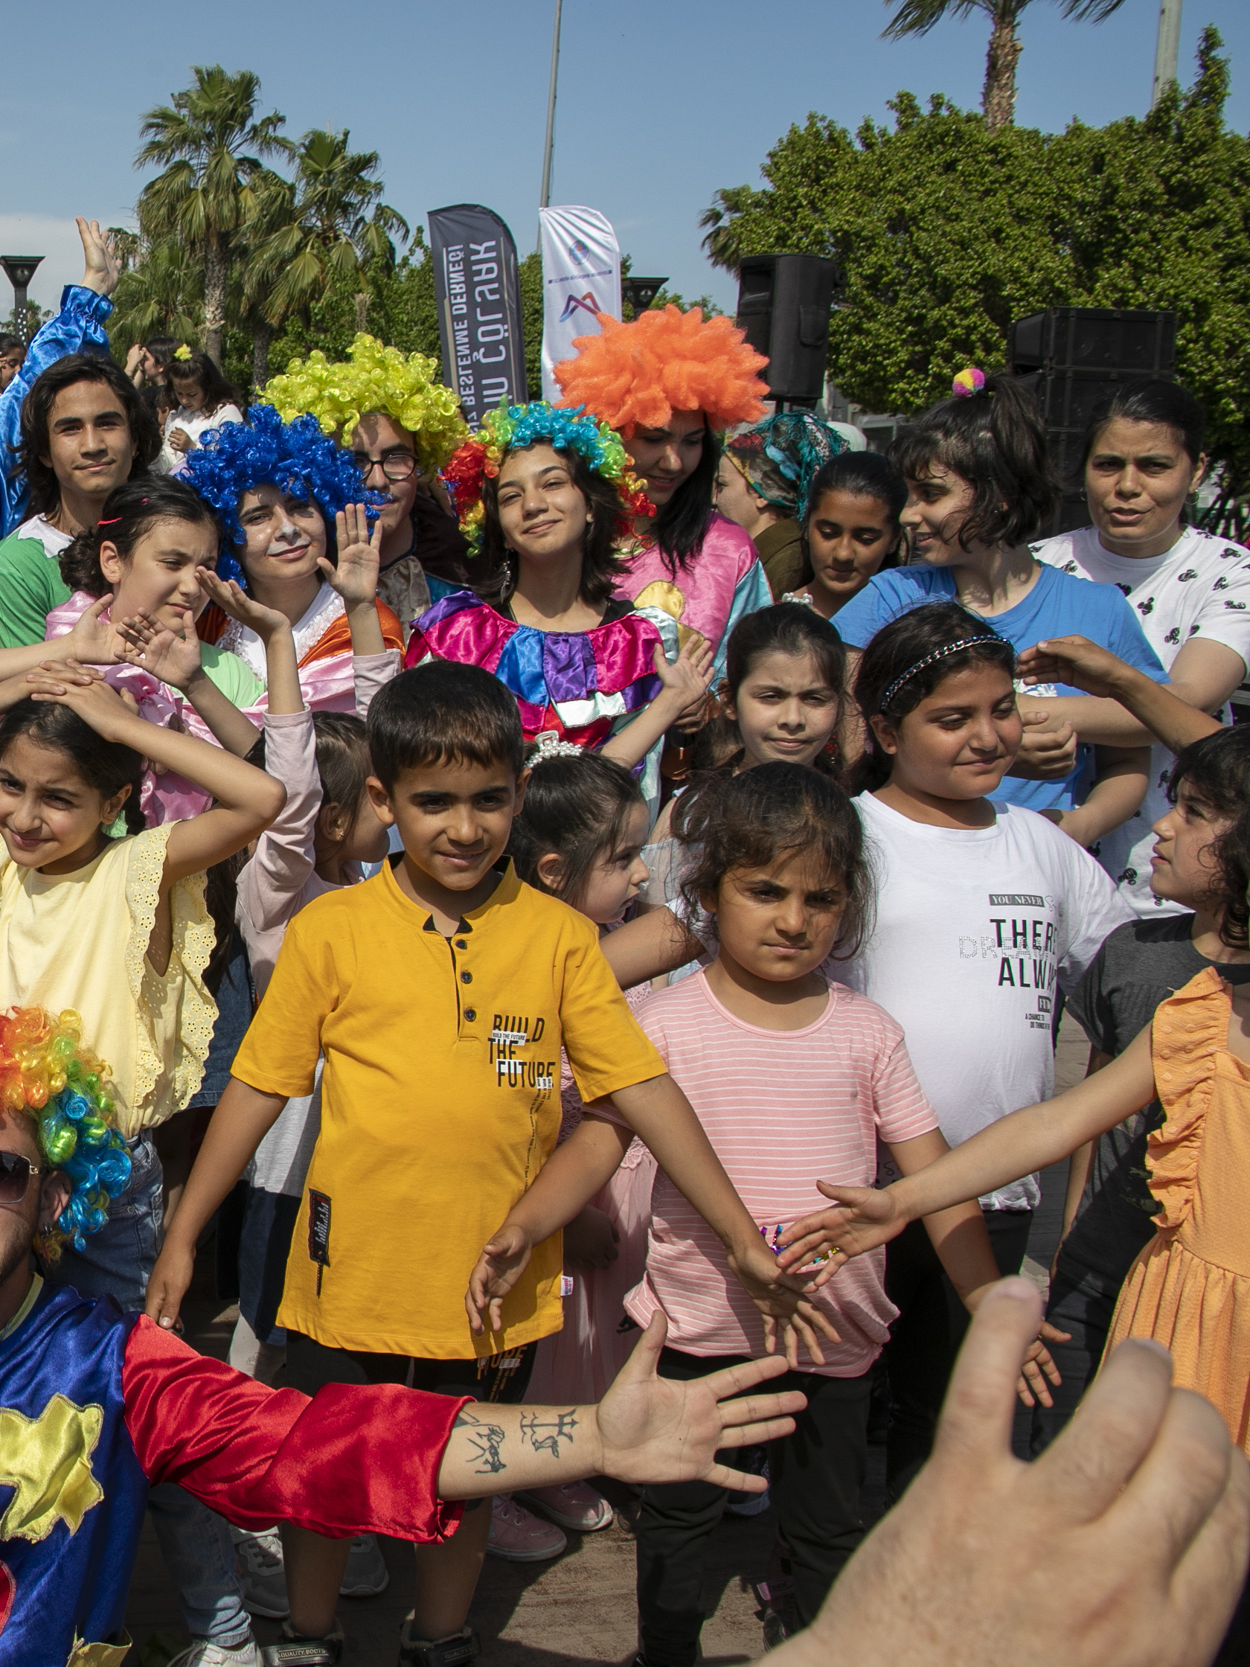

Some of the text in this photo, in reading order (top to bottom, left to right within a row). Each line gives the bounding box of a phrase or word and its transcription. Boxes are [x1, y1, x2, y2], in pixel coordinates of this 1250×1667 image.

[992, 895, 1012, 905] YOU
[1015, 895, 1044, 906] NEVER
[493, 1014, 545, 1043] BUILD
[487, 1037, 519, 1064] THE
[497, 1060, 556, 1088] FUTURE
[281, 1650, 305, 1658] QUALITY
